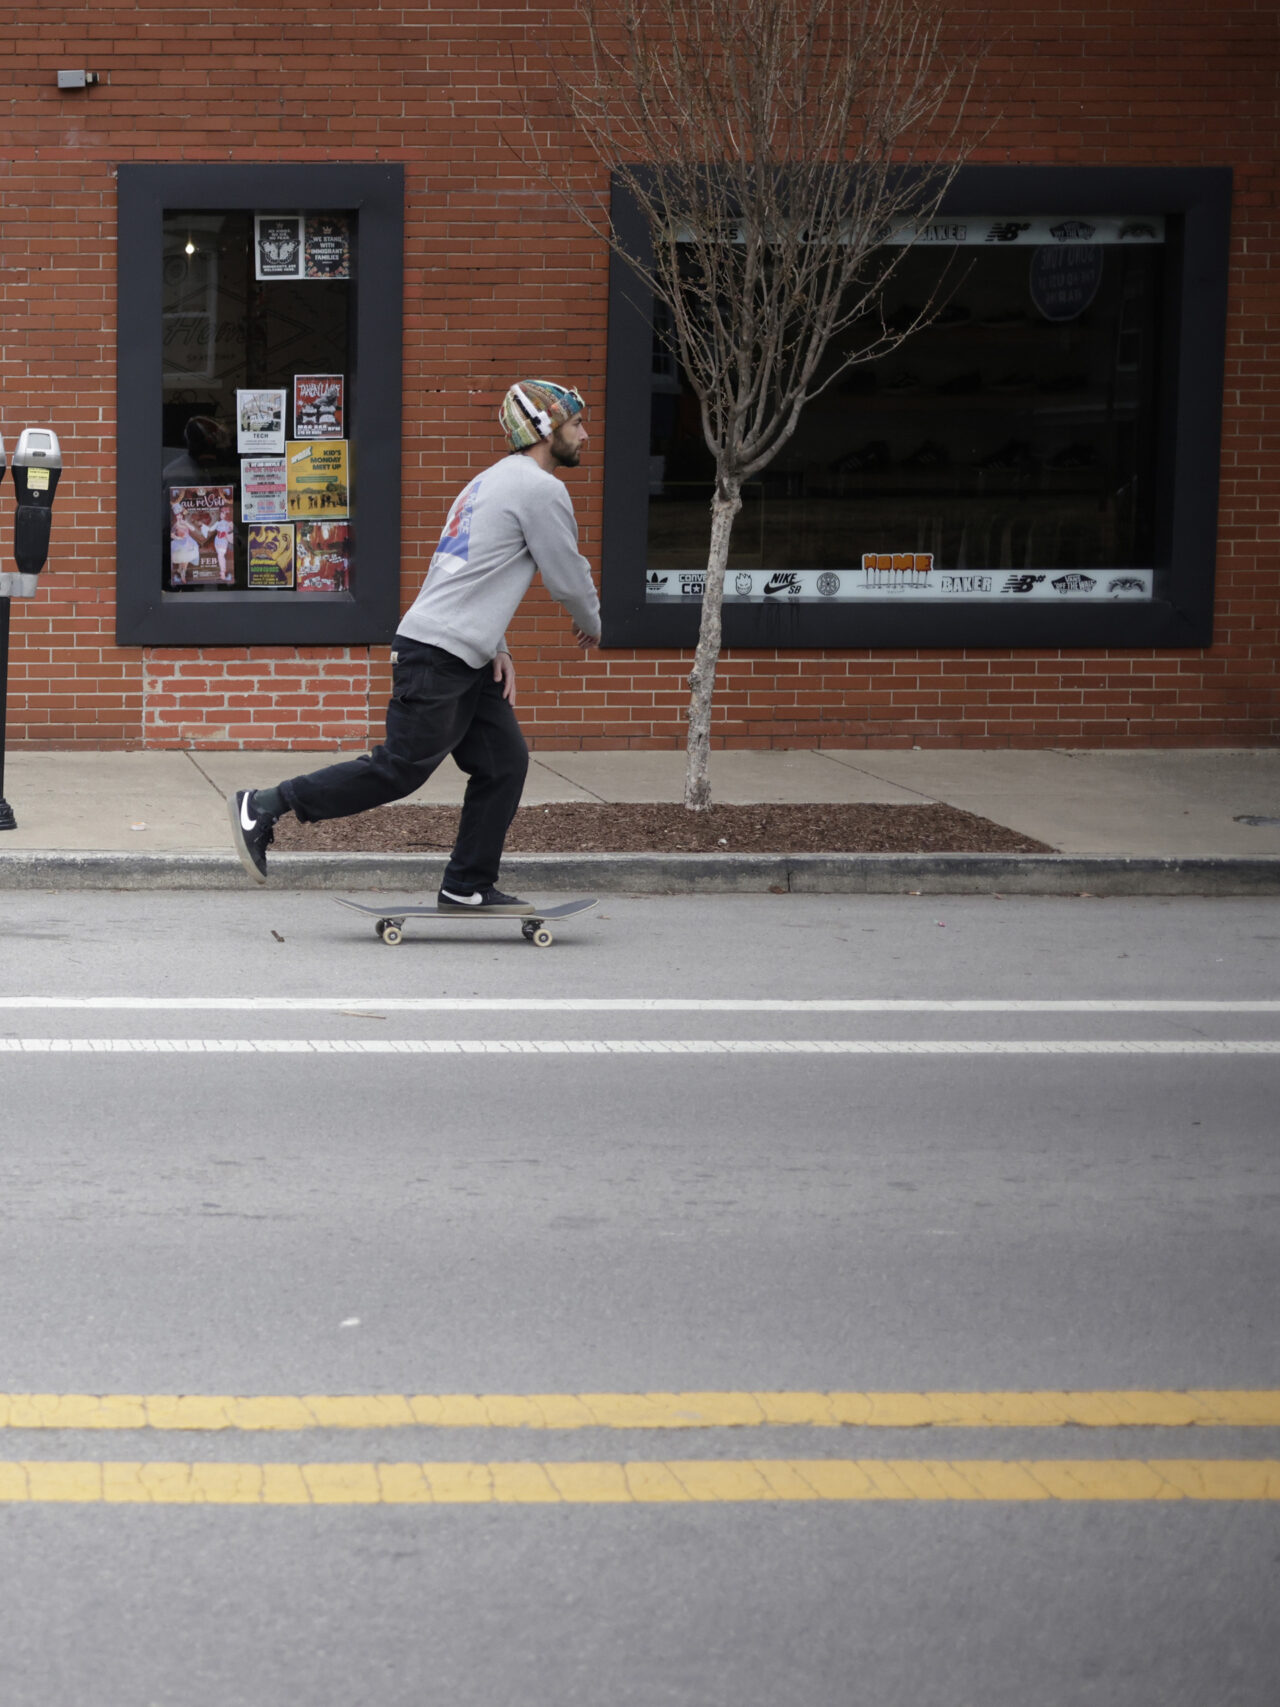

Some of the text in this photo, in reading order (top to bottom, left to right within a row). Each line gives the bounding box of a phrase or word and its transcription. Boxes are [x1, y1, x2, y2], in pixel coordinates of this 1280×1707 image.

[201, 557, 217, 565] FEB
[863, 554, 932, 572] HOME
[771, 573, 798, 584] NIKE
[941, 576, 992, 592] BAKER
[788, 585, 802, 594] SB
